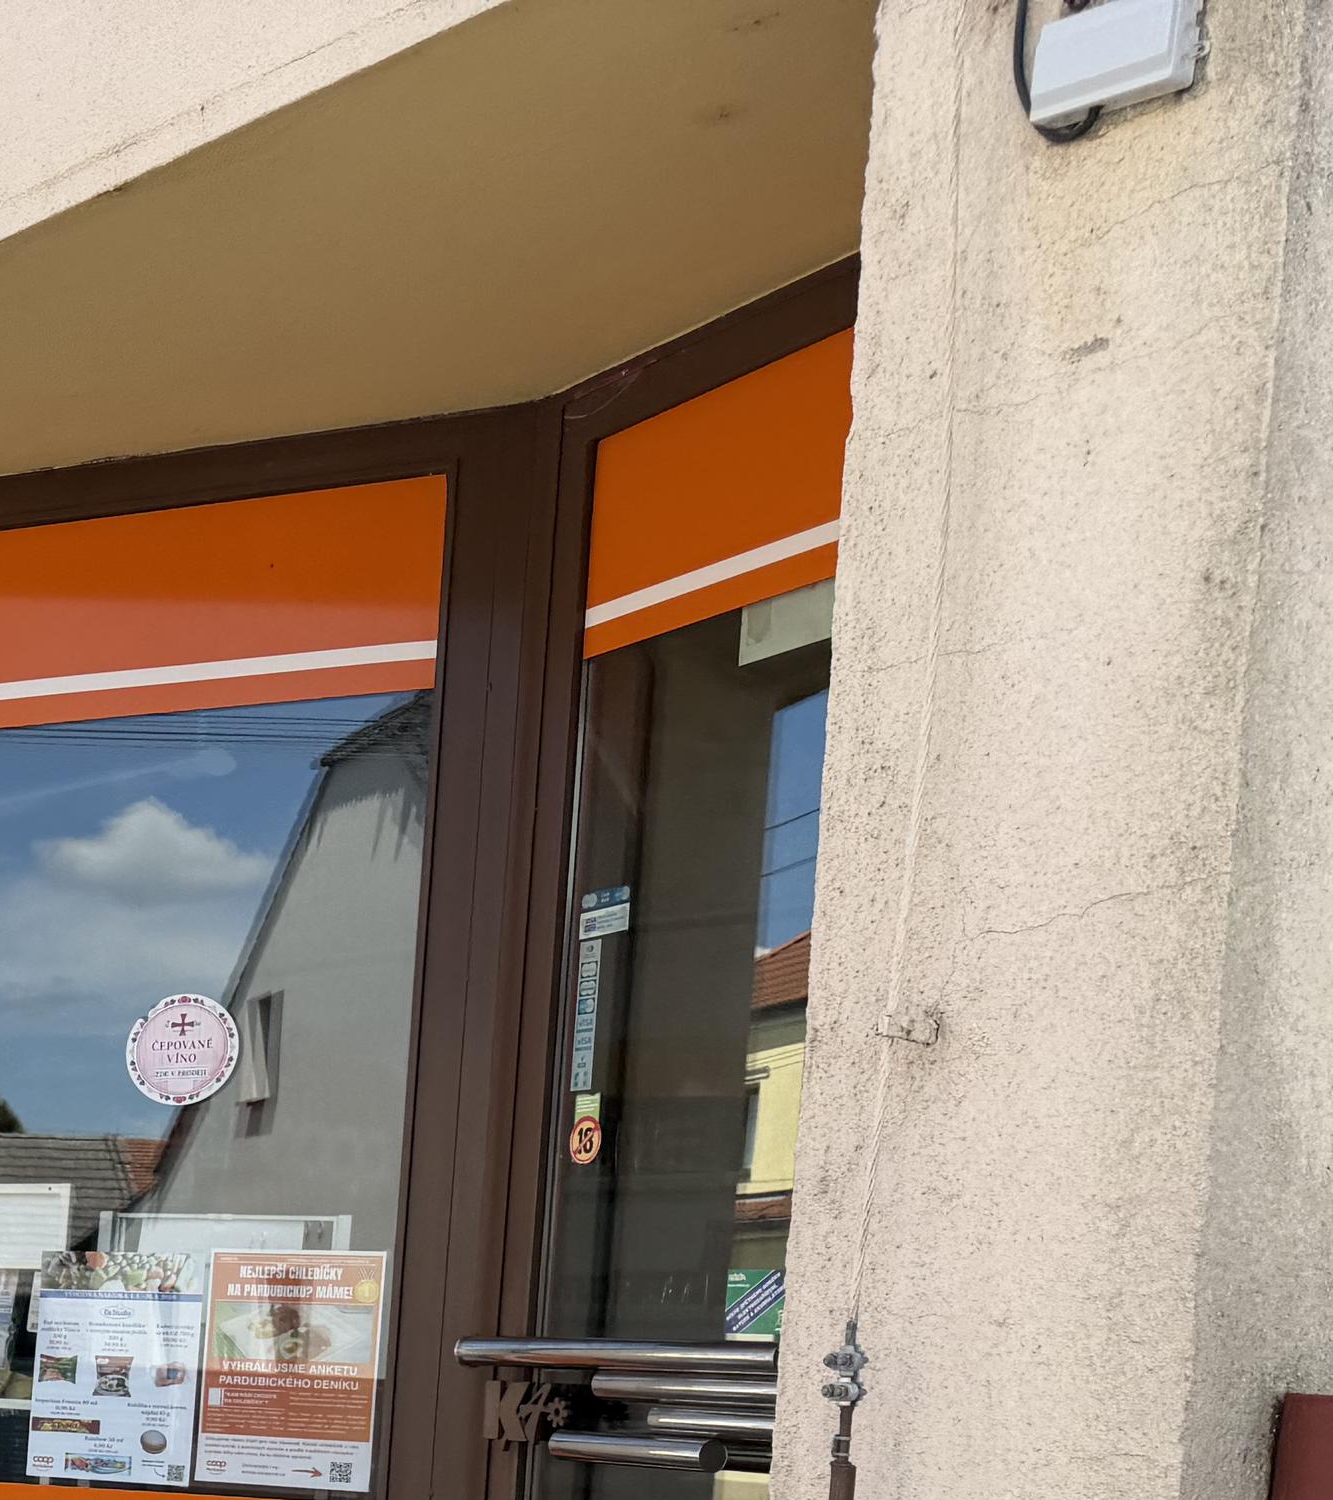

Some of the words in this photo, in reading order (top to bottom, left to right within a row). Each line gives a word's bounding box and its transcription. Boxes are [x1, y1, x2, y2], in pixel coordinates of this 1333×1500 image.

[151, 1038, 213, 1051] ČEPOVANÉ
[167, 1052, 197, 1063] VÍNO
[577, 1127, 594, 1154] 18
[239, 1263, 287, 1279] NEJLEPŠÍ
[227, 1283, 241, 1296] NA
[315, 1284, 353, 1299] MÁME!
[222, 1360, 273, 1373] VYHRÁLI
[274, 1362, 306, 1373] JSME
[309, 1364, 358, 1376] ANKETU
[219, 1375, 311, 1389] PARDUBICKÉHO
[314, 1379, 359, 1391] DENÍKU
[33, 1456, 54, 1465] coop
[206, 1460, 227, 1468] coop
